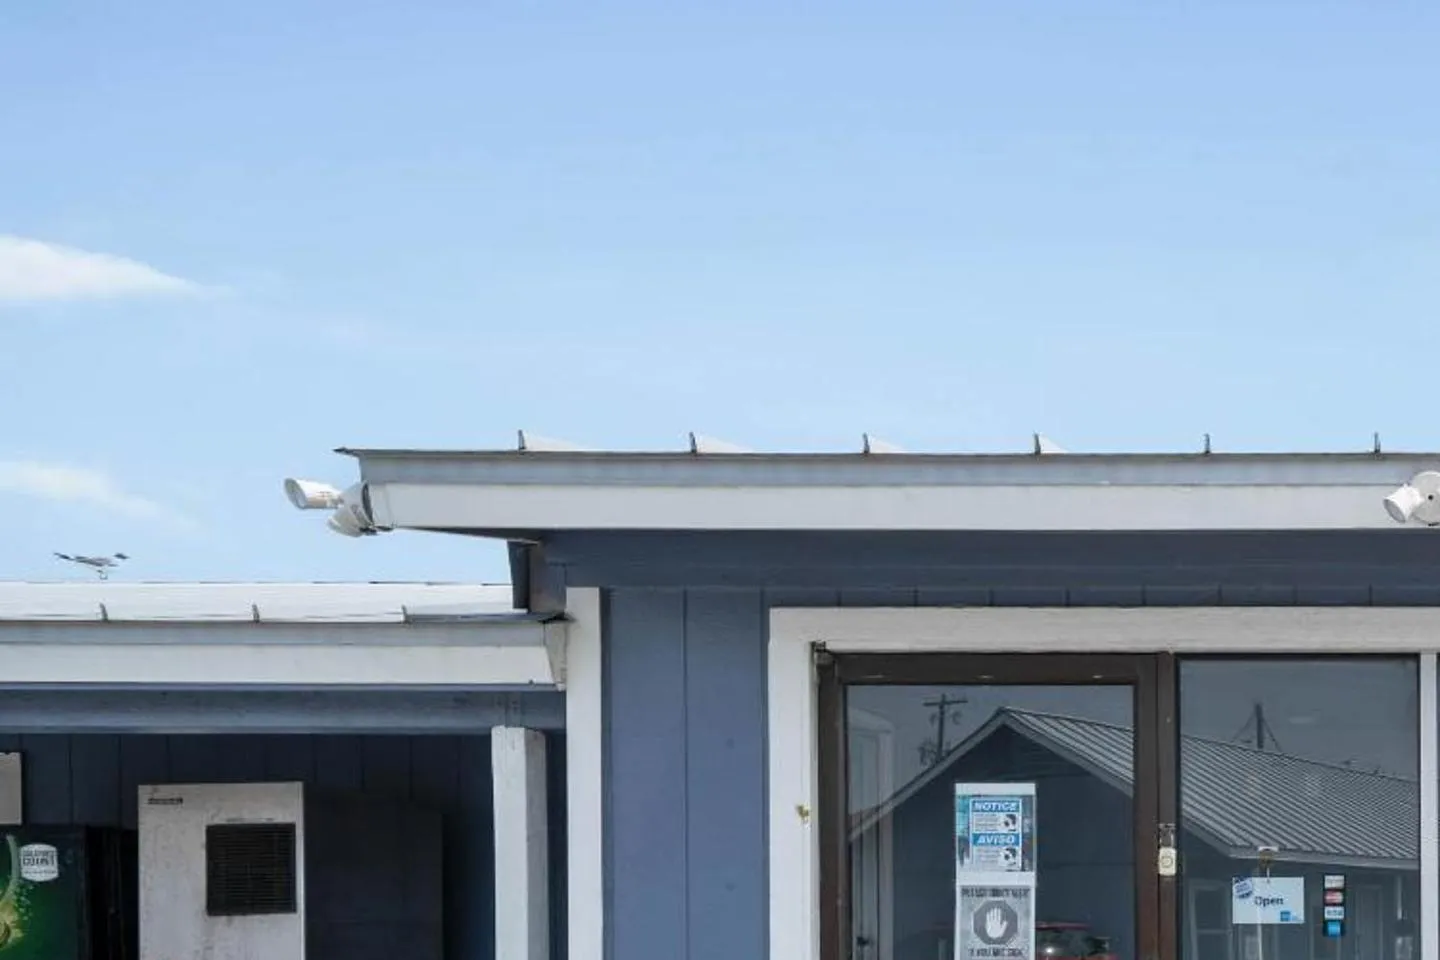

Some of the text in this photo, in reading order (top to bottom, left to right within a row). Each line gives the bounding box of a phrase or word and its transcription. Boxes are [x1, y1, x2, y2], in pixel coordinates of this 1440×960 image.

[974, 802, 1017, 811] NOTICE
[977, 834, 1015, 845] AVISO
[1254, 895, 1284, 907] Open
